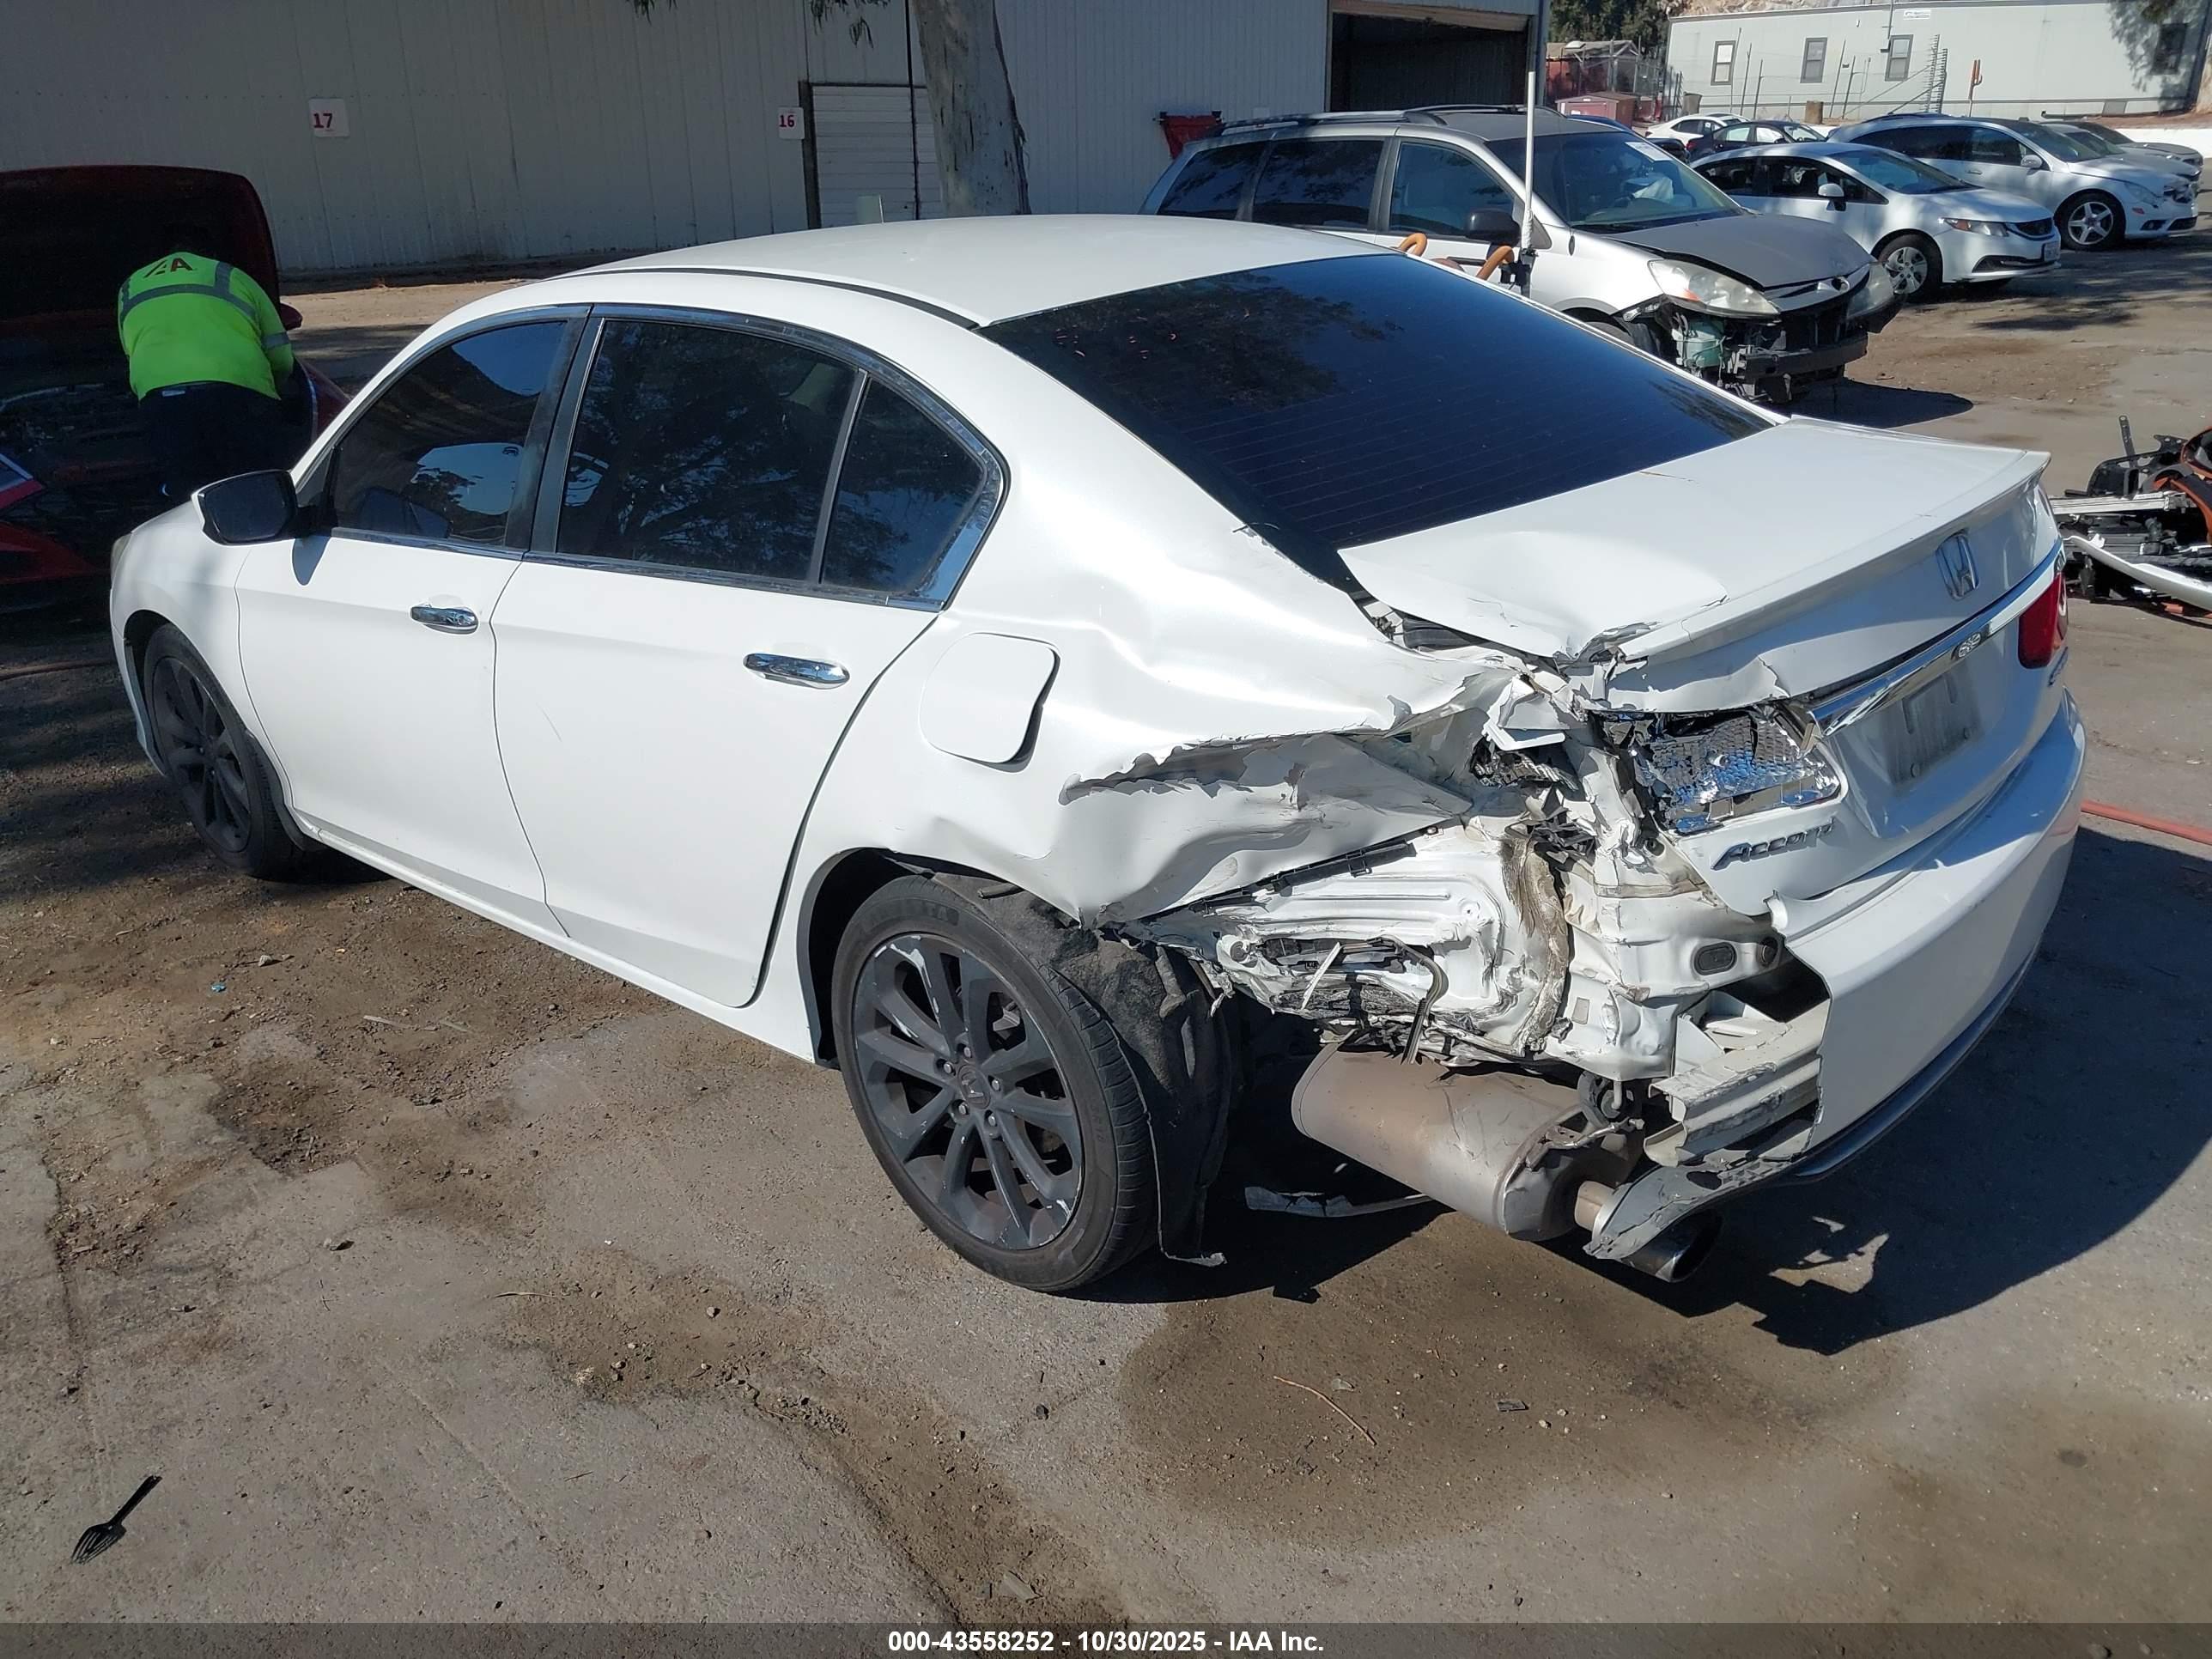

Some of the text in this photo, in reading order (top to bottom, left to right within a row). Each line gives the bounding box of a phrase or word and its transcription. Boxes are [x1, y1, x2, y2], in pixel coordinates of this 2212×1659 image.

[313, 112, 332, 128] 17
[779, 114, 794, 127] 16
[1711, 816, 1834, 871] Accord
